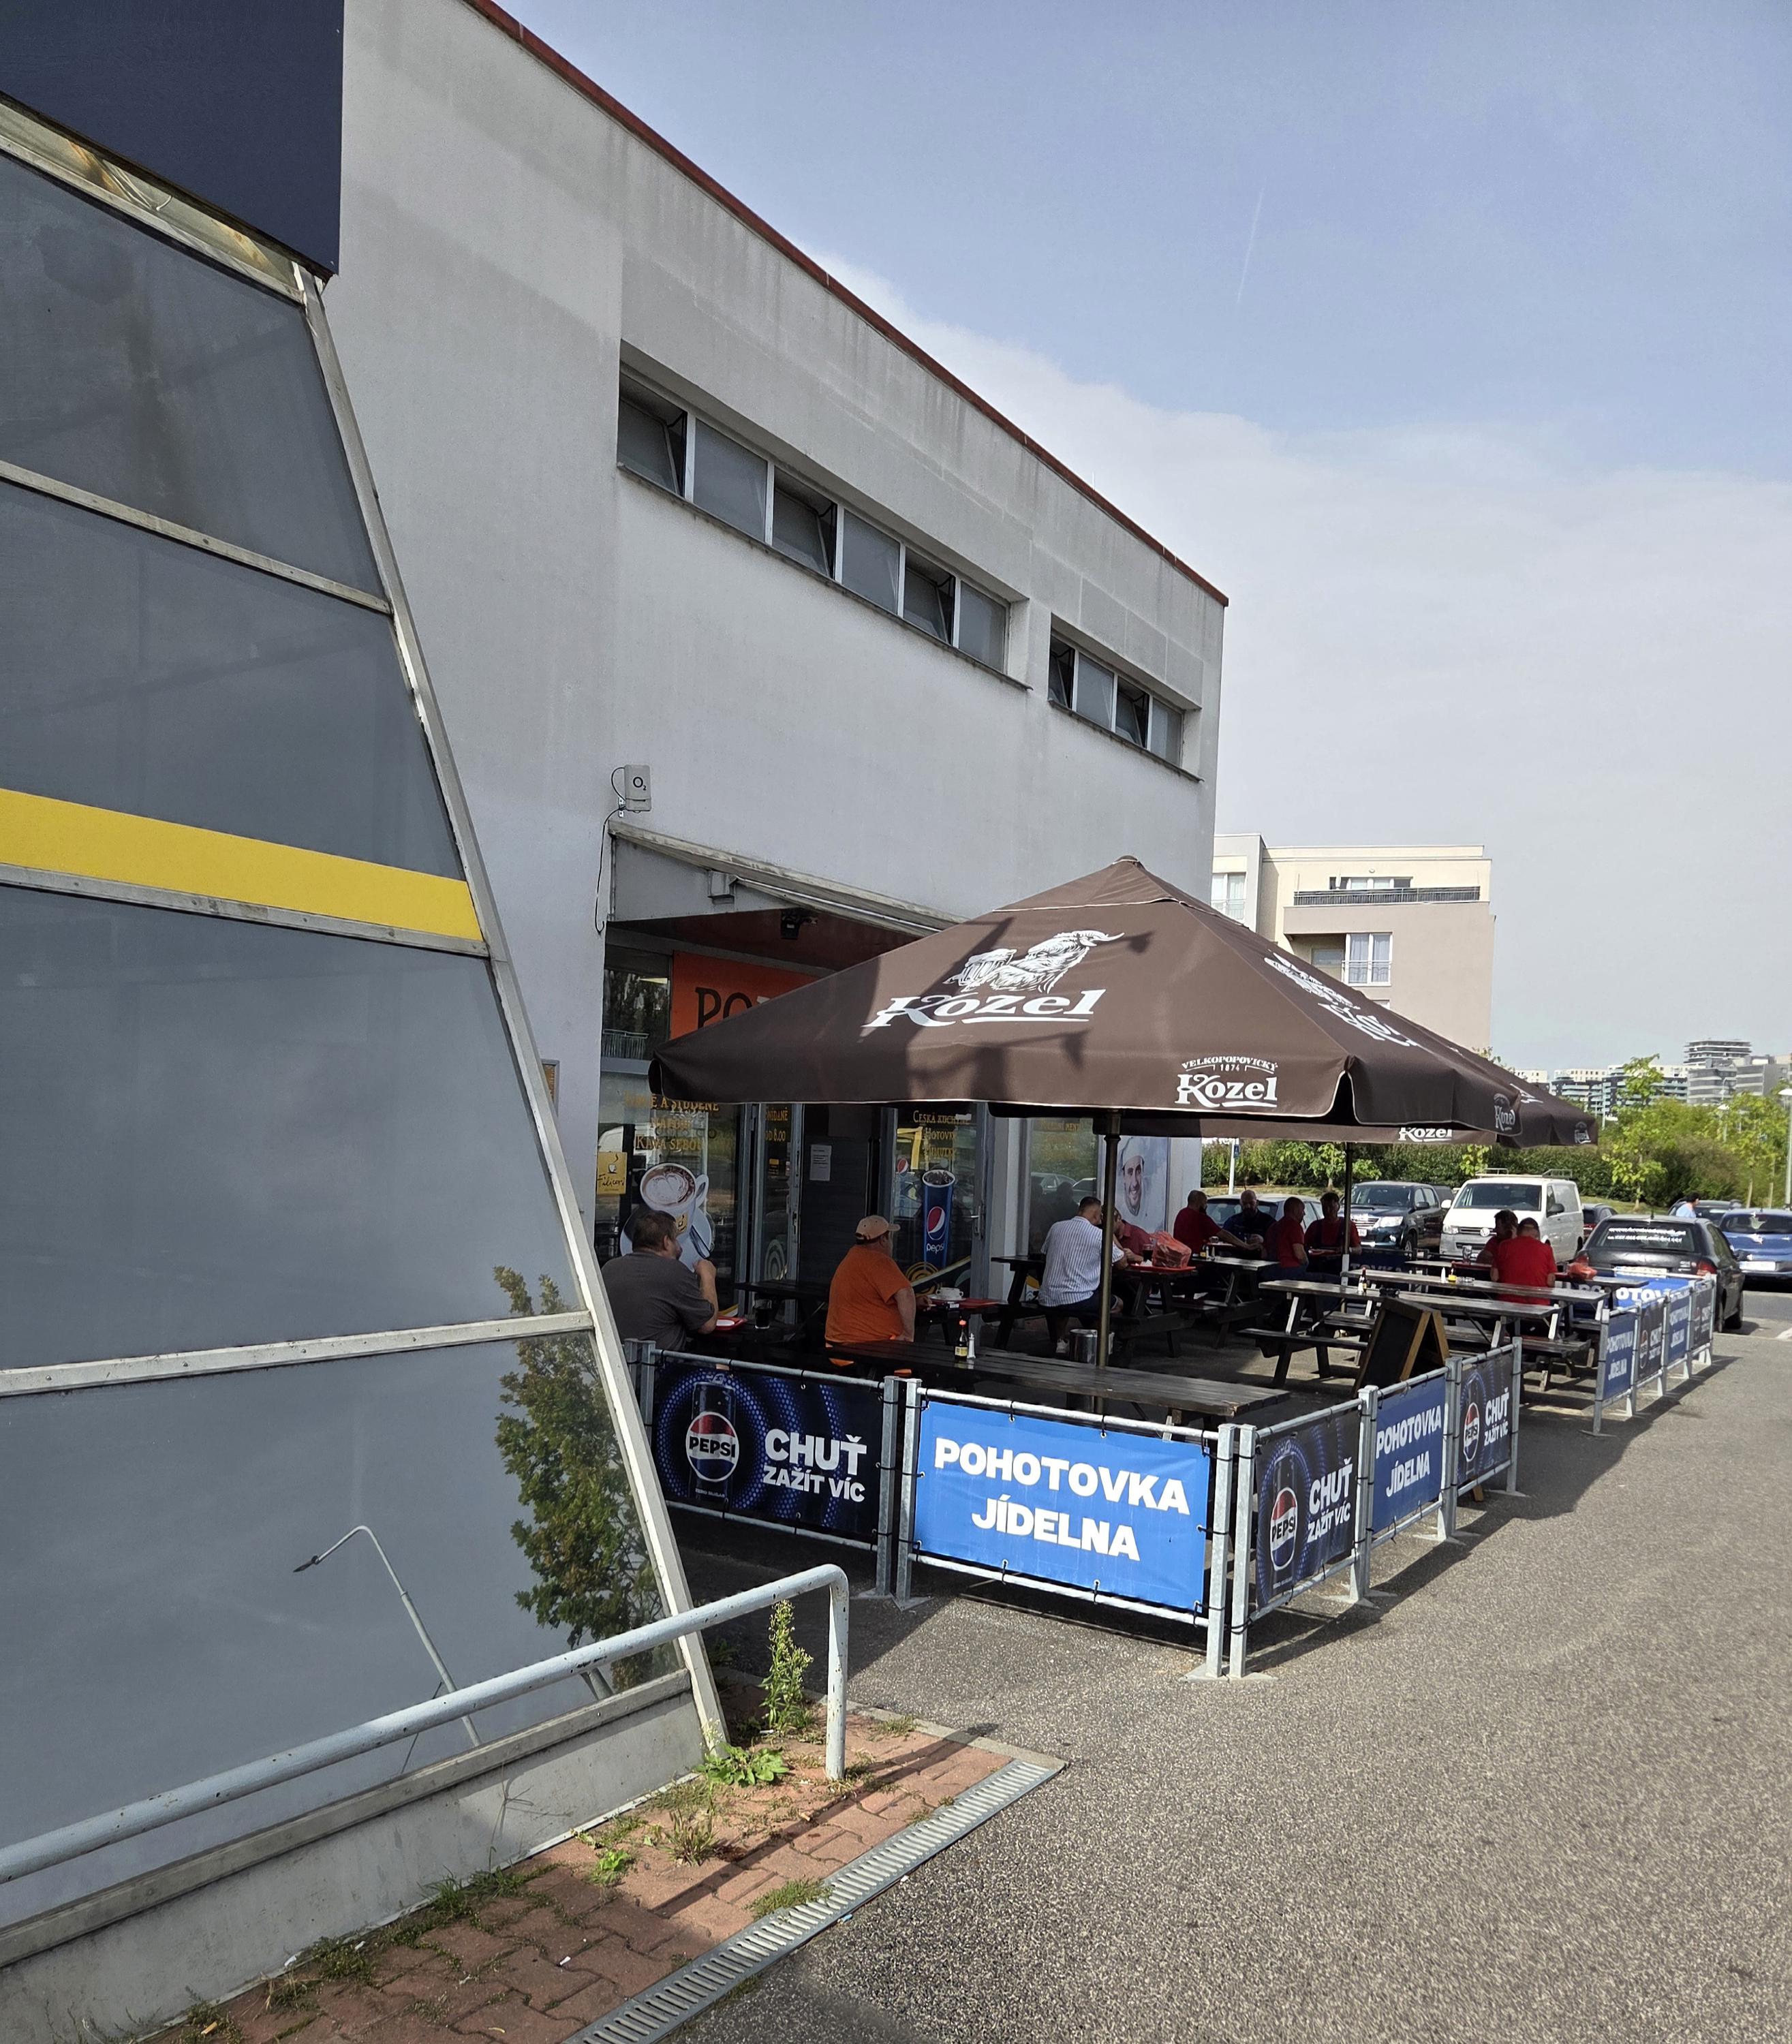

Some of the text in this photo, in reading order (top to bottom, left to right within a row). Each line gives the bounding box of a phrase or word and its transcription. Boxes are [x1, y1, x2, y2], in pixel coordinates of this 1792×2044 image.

[633, 777, 647, 790] O2
[861, 989, 1107, 1027] Kozel
[1181, 1056, 1278, 1072] VELKOPOPOVICKÝ
[1175, 1074, 1278, 1108] Kozel
[1398, 1127, 1453, 1142] Kozel
[1485, 1387, 1509, 1426] CHUŤ
[689, 1436, 736, 1458] PEPSI
[1376, 1405, 1442, 1459] POHOTOVKA
[764, 1428, 867, 1476] CHUŤ
[762, 1465, 865, 1502] ZAŽÍT VÍC
[934, 1438, 1190, 1515] POHOTOVKA
[1310, 1457, 1353, 1515] CHUŤ
[1386, 1451, 1430, 1498] JÍDELNA
[971, 1494, 1141, 1561] JÍDELNA
[1307, 1500, 1350, 1543] ZAŽÍT VÍC
